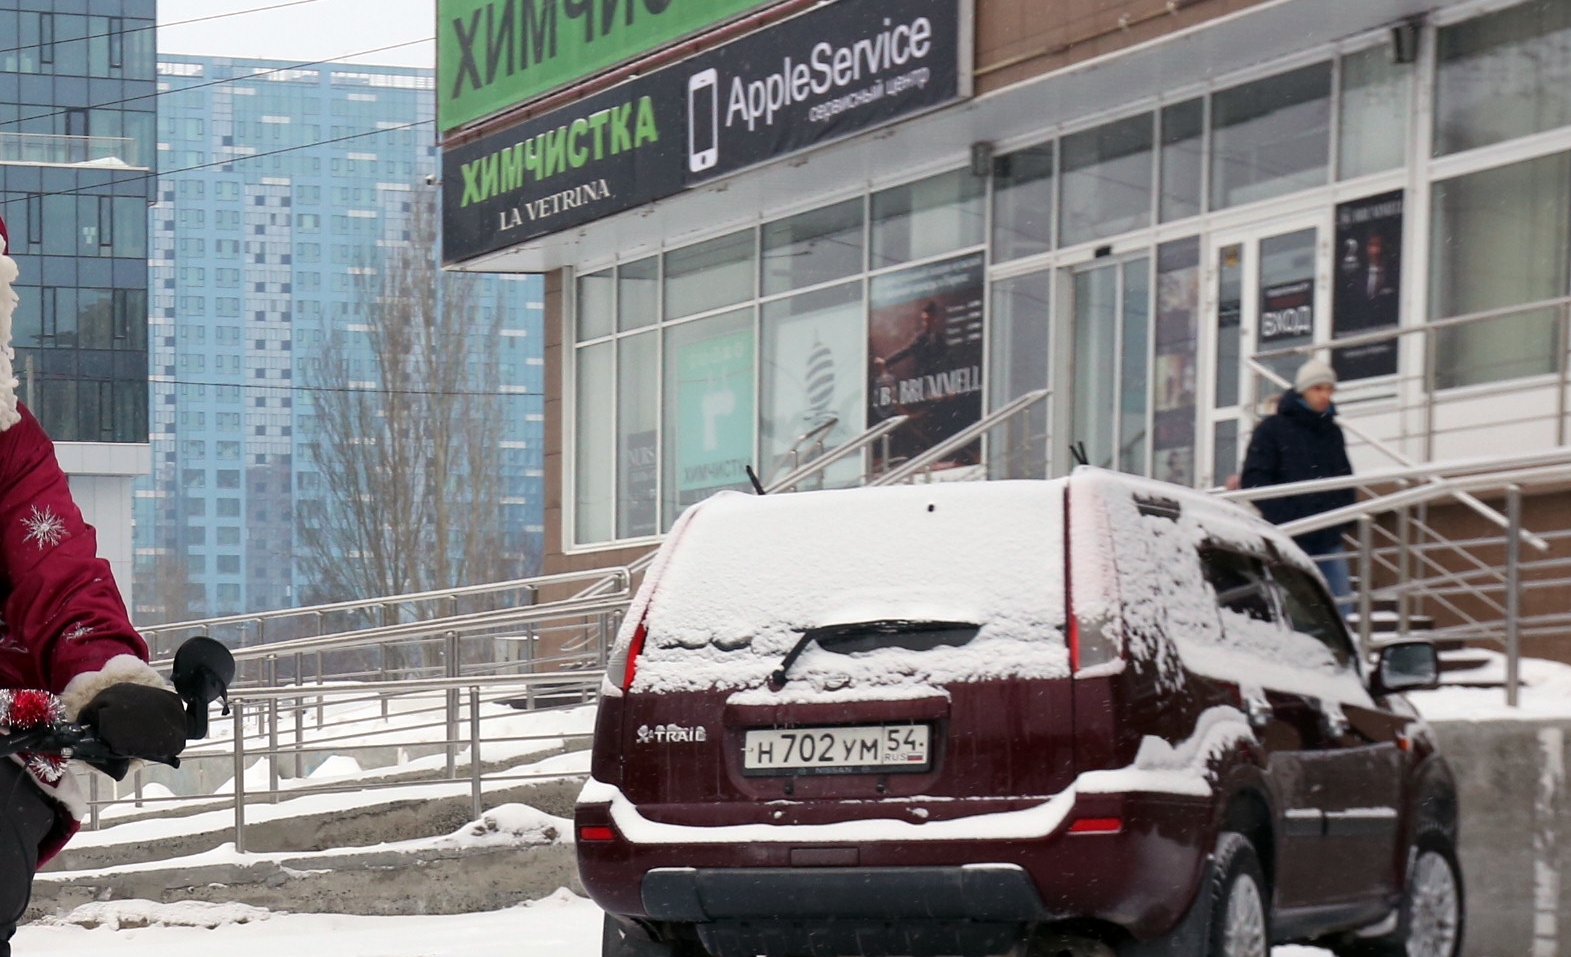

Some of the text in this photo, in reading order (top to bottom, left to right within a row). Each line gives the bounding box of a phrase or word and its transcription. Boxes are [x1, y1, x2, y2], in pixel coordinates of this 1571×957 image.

[725, 17, 932, 131] AppleService
[809, 67, 930, 122] сервисный центр
[460, 96, 659, 208] ХИМЧИСТКА
[500, 179, 611, 231] LA VETRINA
[1262, 305, 1312, 337] ВХОД
[884, 752, 907, 762] RUS
[887, 728, 918, 752] 54
